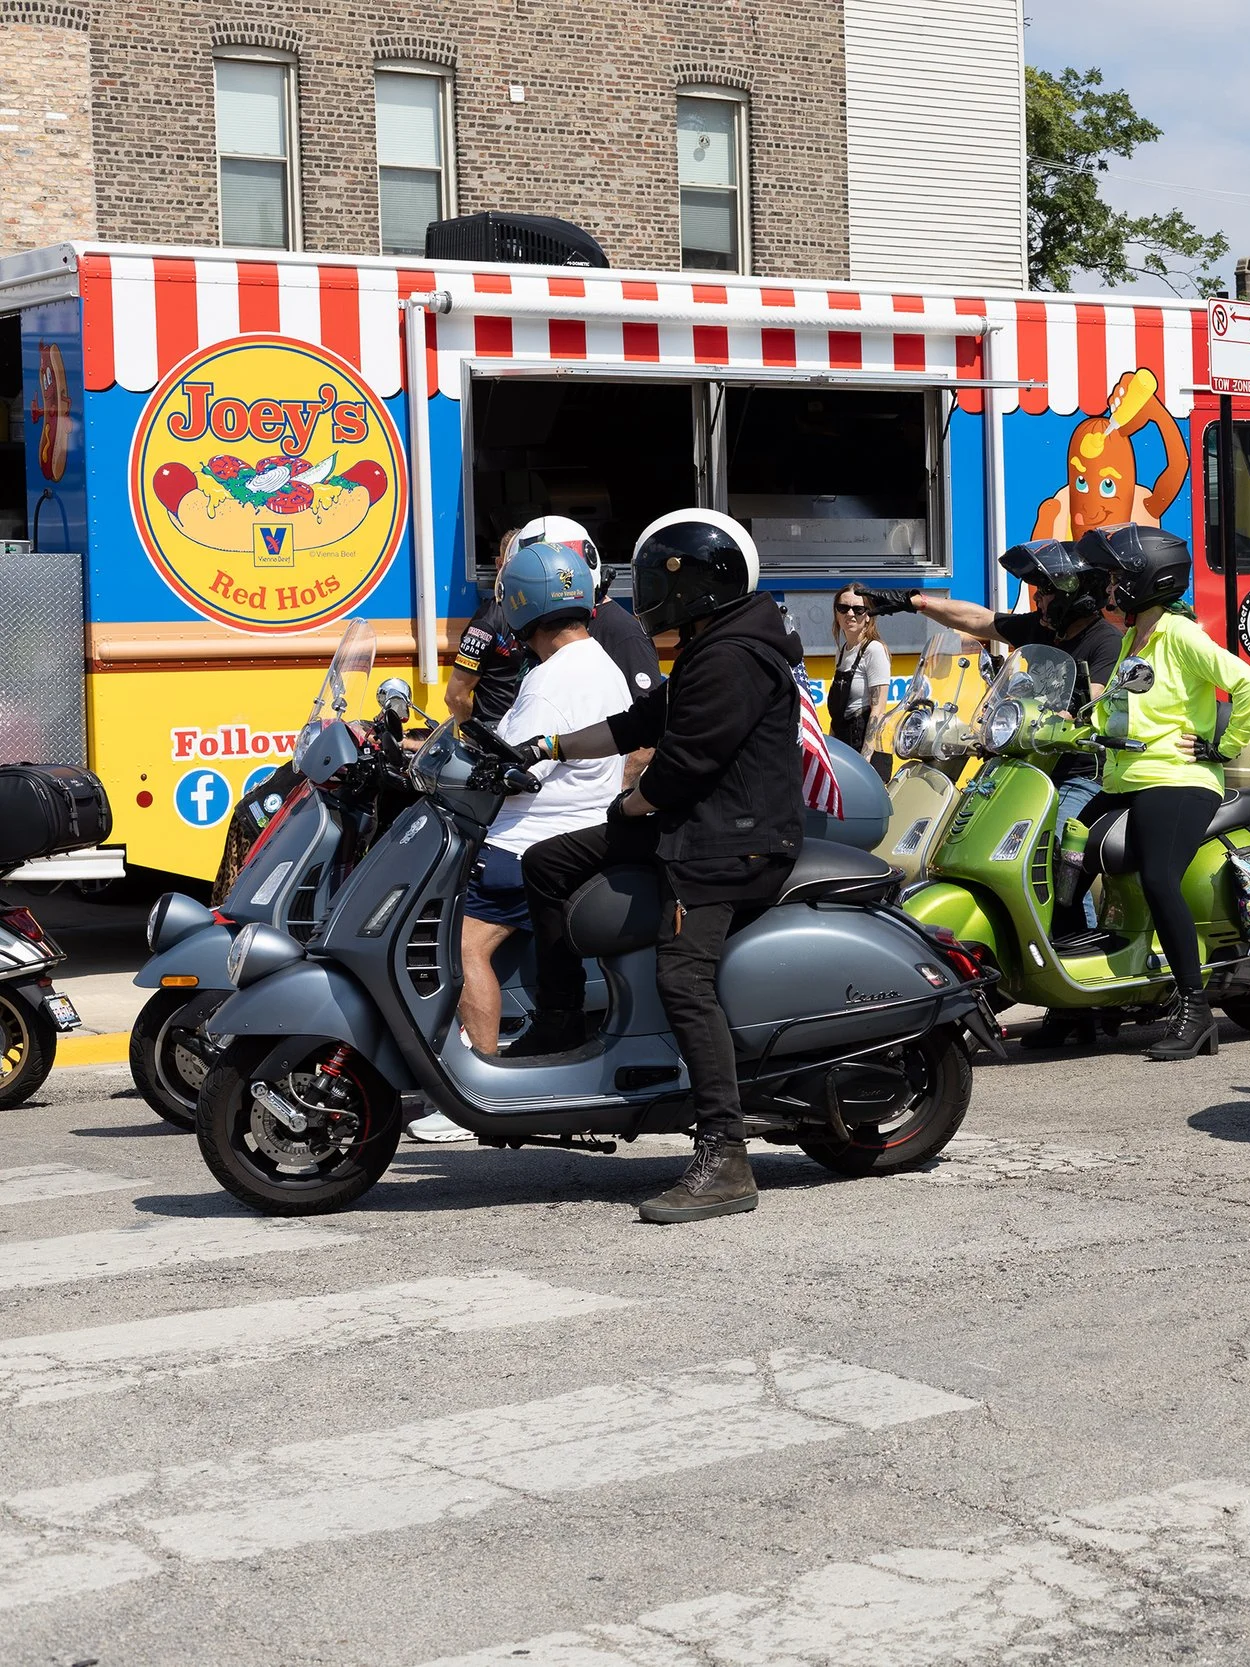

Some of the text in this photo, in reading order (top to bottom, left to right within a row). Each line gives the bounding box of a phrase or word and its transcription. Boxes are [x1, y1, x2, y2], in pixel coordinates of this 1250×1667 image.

[1213, 378, 1230, 391] TOW
[168, 382, 369, 459] Joey's
[277, 556, 291, 564] Beef
[208, 569, 341, 611] Red Hots
[1238, 605, 1249, 631] Beef
[174, 727, 297, 758] Follow
